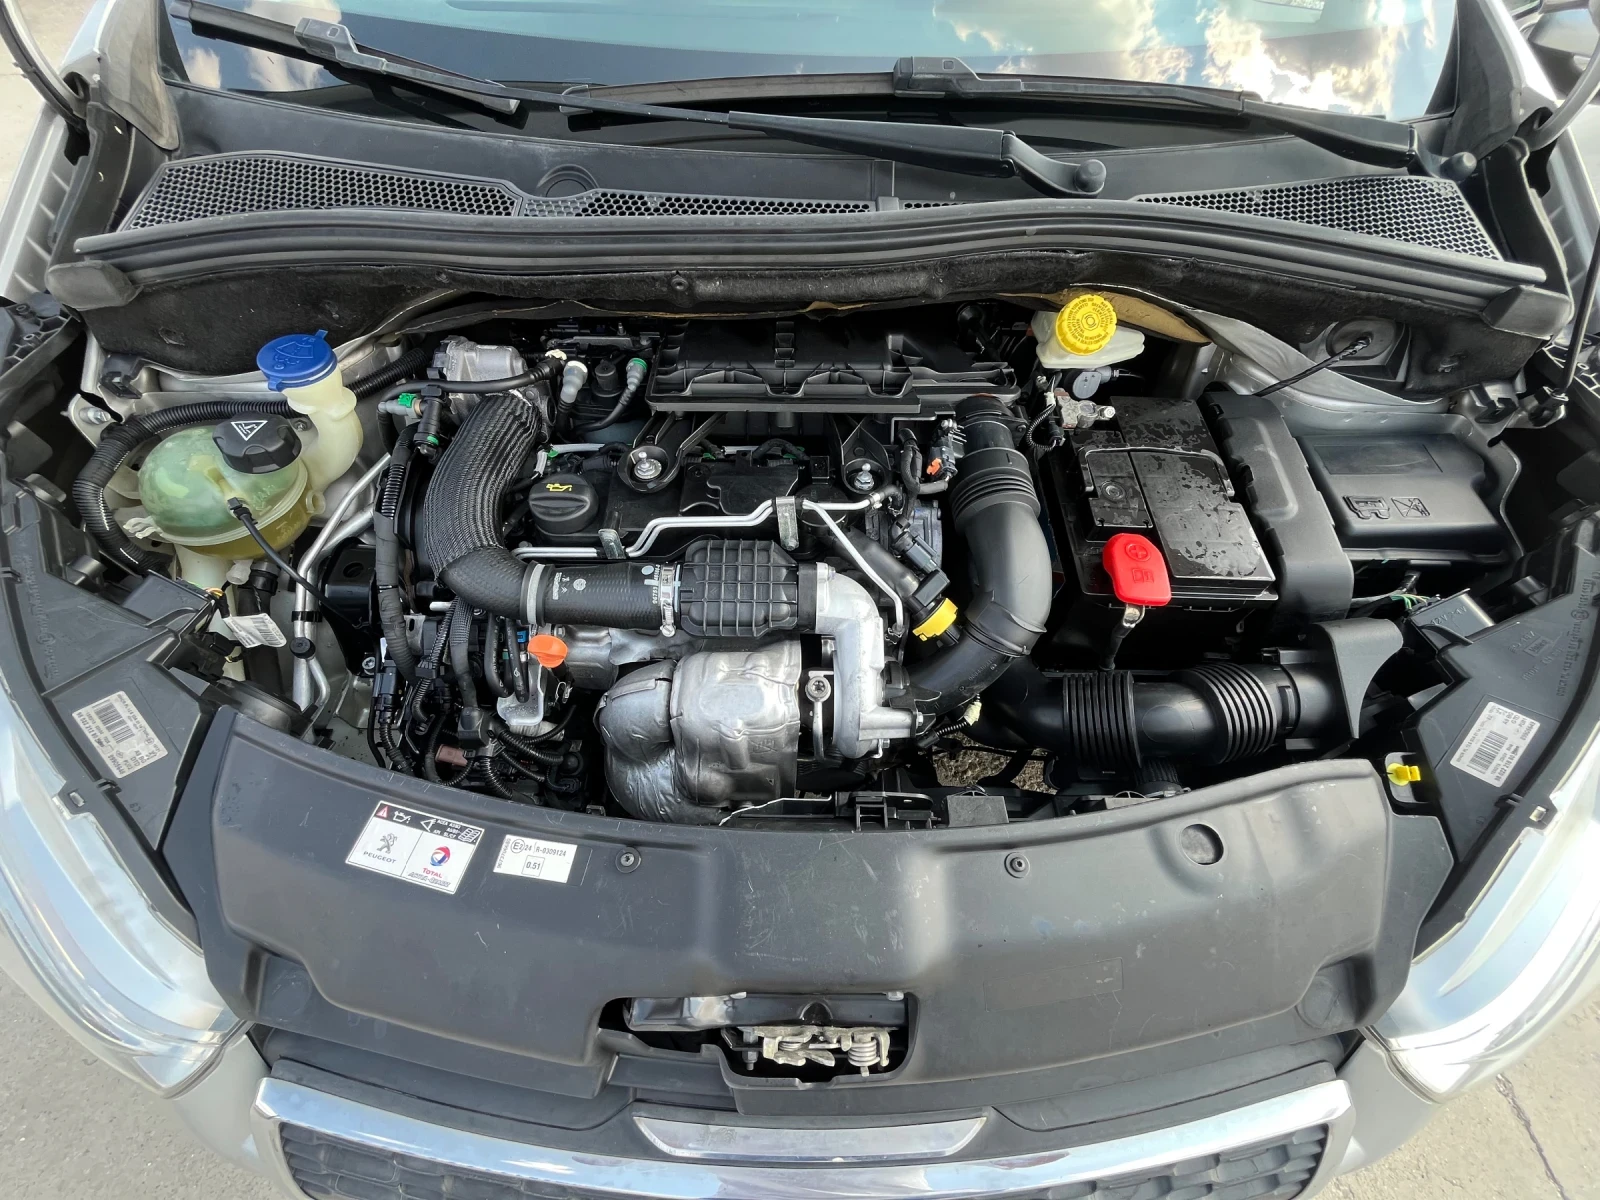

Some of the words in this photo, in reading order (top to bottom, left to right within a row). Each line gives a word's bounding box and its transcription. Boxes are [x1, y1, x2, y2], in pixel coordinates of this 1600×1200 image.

[363, 851, 396, 864] PEUGEOT
[525, 861, 541, 870] 0.51
[422, 867, 443, 878] TOTAL
